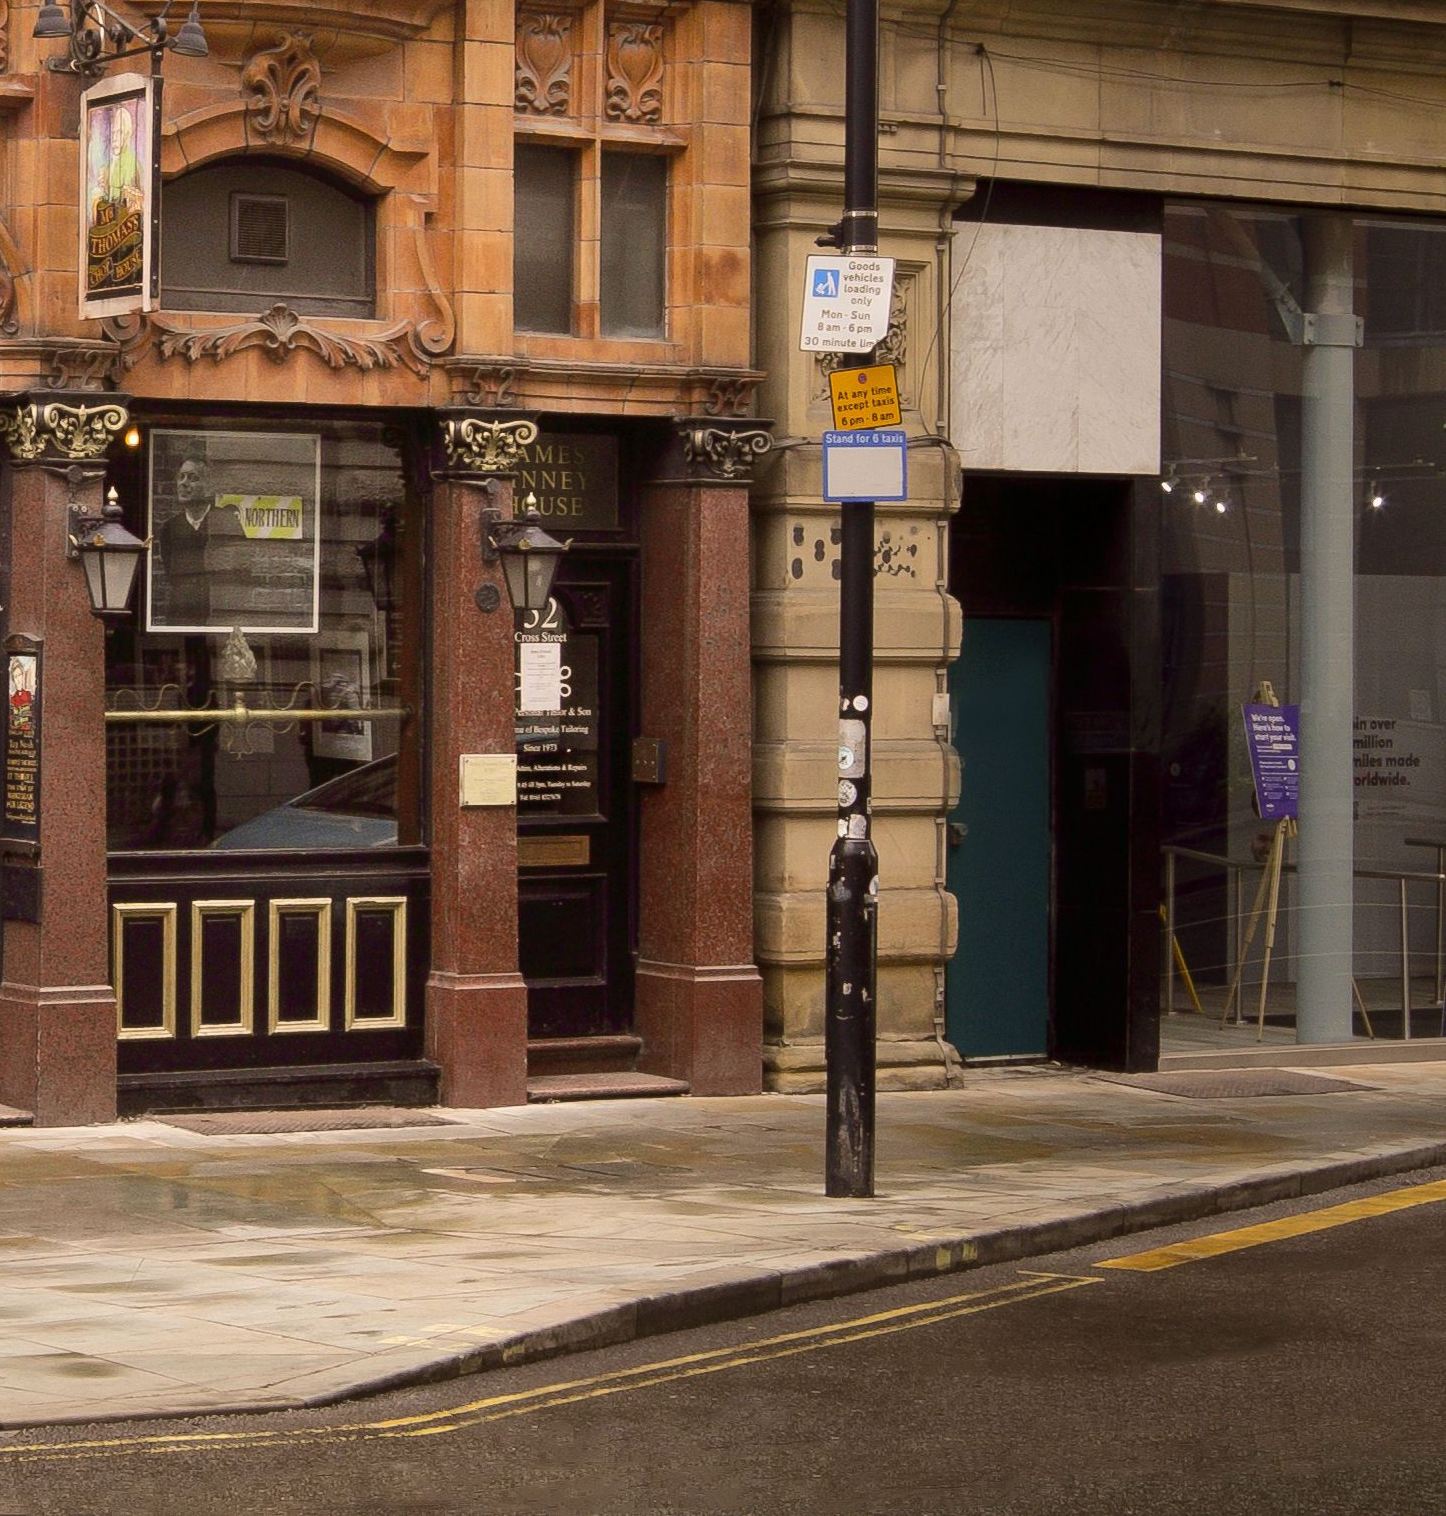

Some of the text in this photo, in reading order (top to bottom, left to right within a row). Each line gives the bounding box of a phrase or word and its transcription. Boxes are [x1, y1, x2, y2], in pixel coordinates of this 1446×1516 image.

[848, 261, 880, 271] Goods
[843, 273, 884, 282] vehicles
[844, 284, 881, 295] loading
[851, 296, 872, 306] only
[821, 310, 843, 319] Mon
[850, 311, 870, 320] Sun
[817, 322, 823, 331] 8
[848, 324, 854, 333] 6
[856, 325, 872, 333] pm
[805, 337, 819, 345] 30
[822, 339, 856, 347] minute
[467, 367, 516, 404] 52
[837, 386, 892, 400] At any time
[837, 396, 895, 412] except taxis
[841, 417, 848, 426] 6
[849, 417, 864, 426] pm
[872, 413, 878, 422] 8
[880, 413, 894, 421] am
[825, 434, 903, 443] Stand for 6 taxis
[516, 445, 585, 464] AMES
[245, 508, 299, 528] NORTHERN
[514, 632, 567, 642] Cross Street
[568, 708, 575, 716] &
[577, 707, 591, 716] Son
[1370, 719, 1396, 730] over
[523, 744, 541, 752] Since
[1386, 752, 1420, 767] made
[1353, 772, 1410, 787] orldwide.
